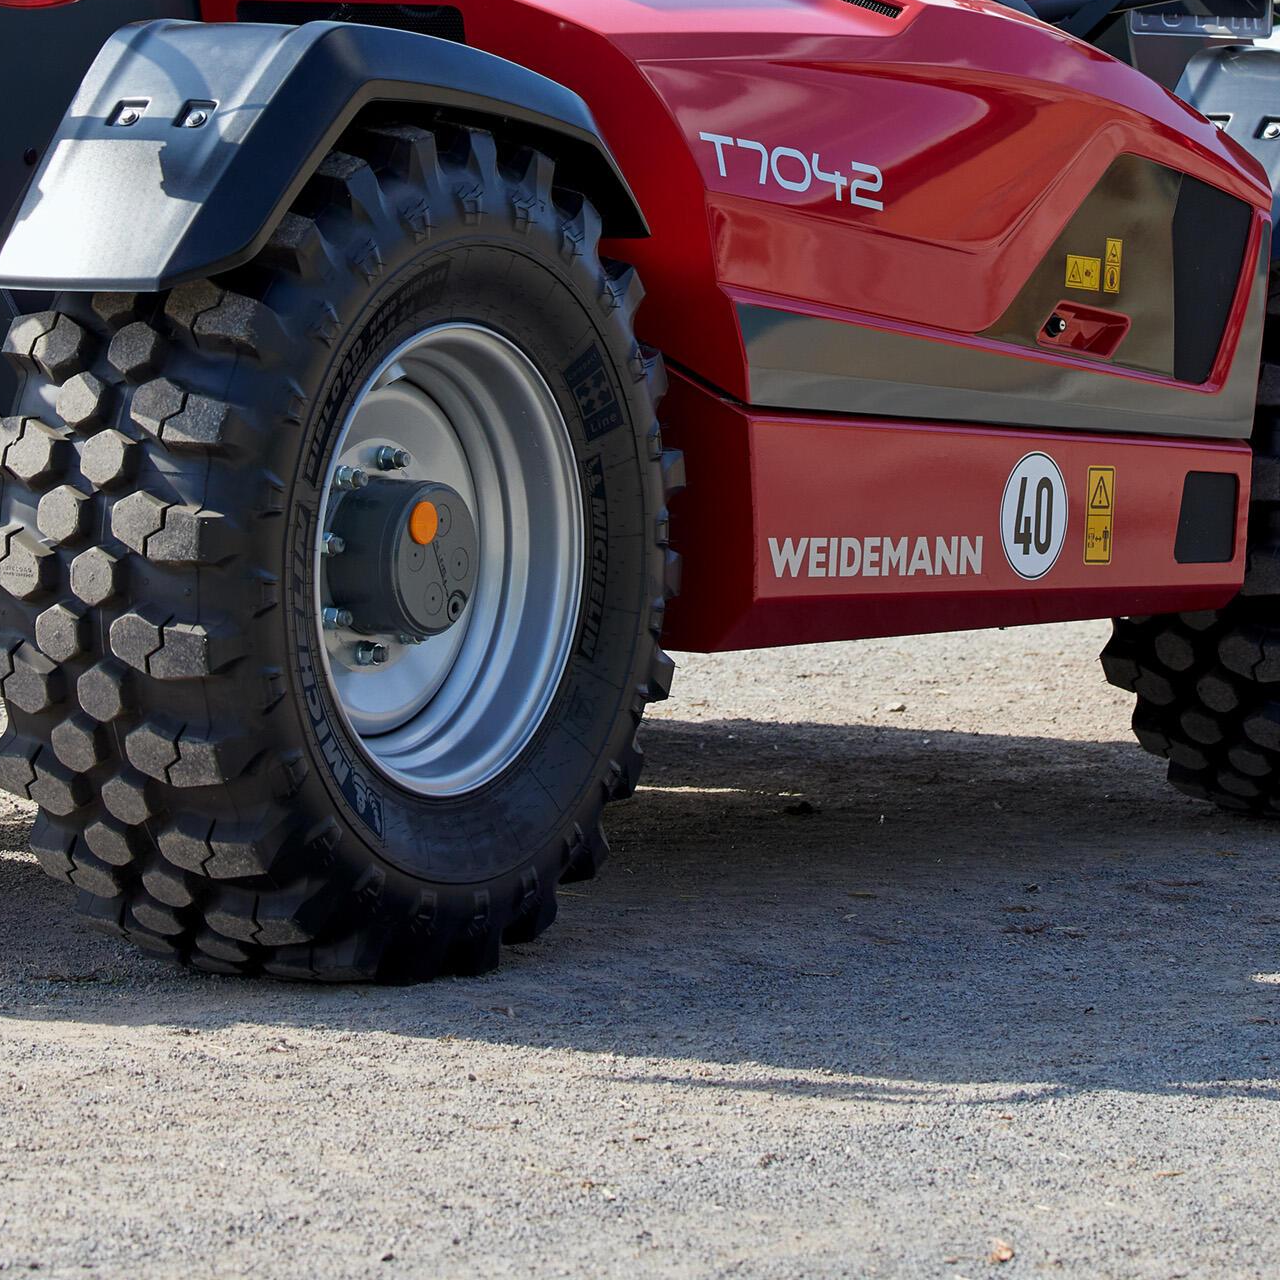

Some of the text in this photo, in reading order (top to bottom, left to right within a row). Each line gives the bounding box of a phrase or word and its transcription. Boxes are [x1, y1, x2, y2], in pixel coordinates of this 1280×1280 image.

[699, 131, 884, 211] T7042
[1014, 477, 1053, 554] 40
[580, 497, 607, 659] MICHELIN
[768, 536, 983, 577] WEIDEMANN
